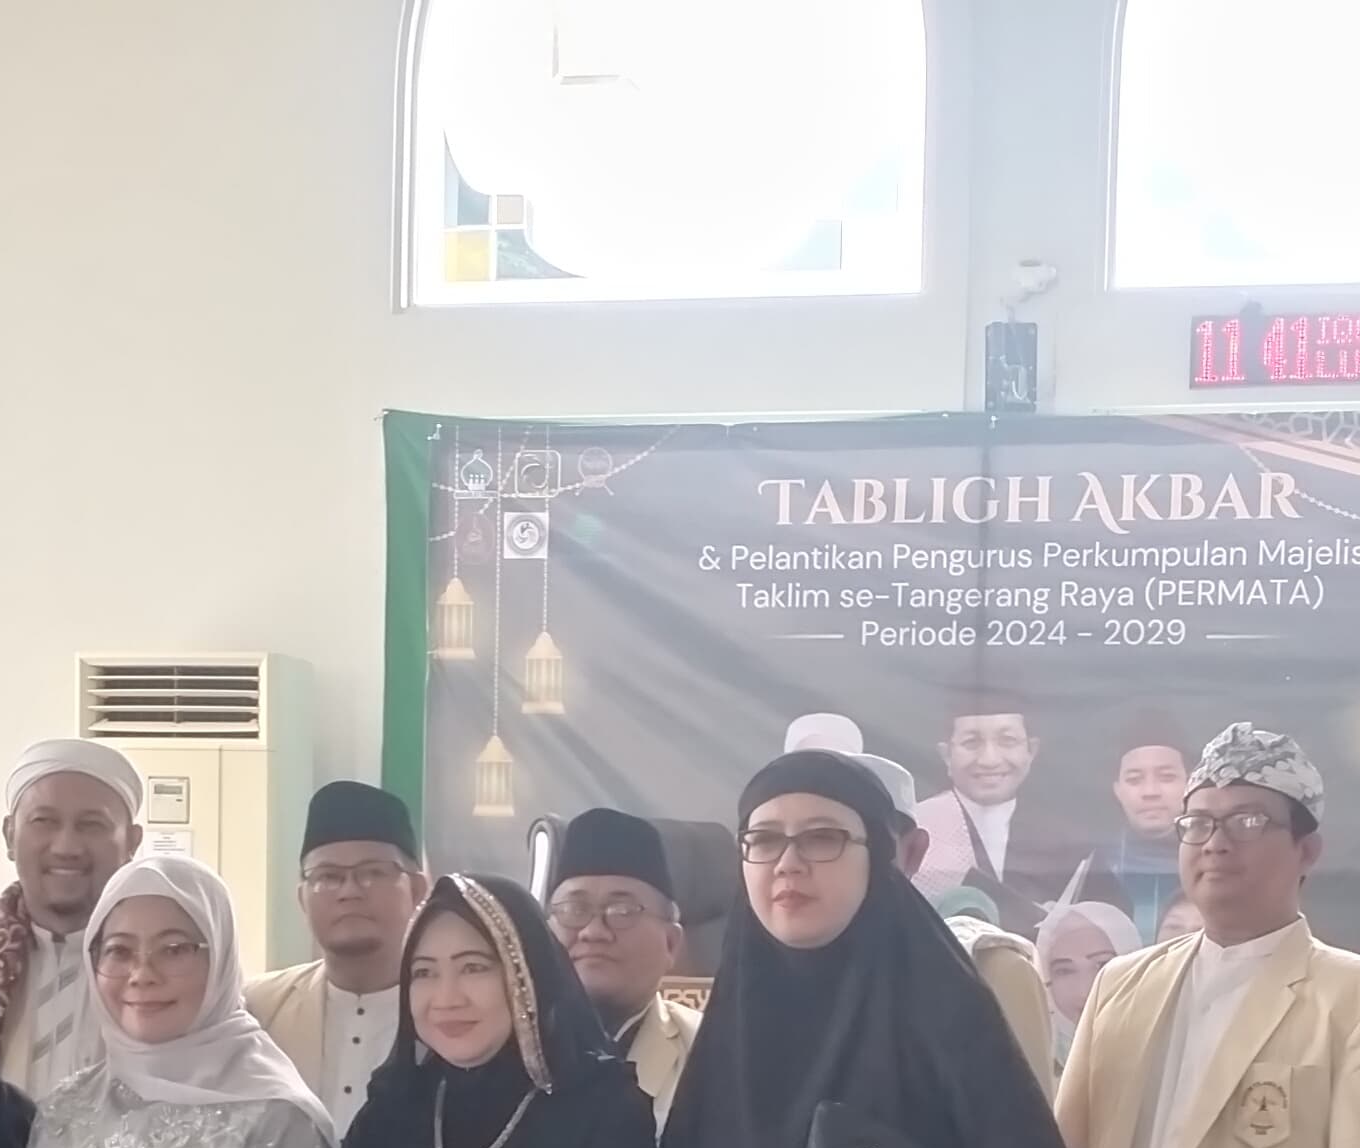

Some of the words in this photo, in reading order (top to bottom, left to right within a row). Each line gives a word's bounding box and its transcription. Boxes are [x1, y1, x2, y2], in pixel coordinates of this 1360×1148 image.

[757, 475, 1053, 526] TABLIGH
[1070, 471, 1304, 535] AKBAR
[698, 544, 721, 571] &
[731, 544, 883, 571] Pelantikan
[892, 543, 1033, 576] Pengurus
[1042, 539, 1248, 574] Perkumpulan
[736, 582, 830, 609] Taklim
[839, 581, 1051, 615] se-Tangerang
[1060, 580, 1135, 614] Raya
[1144, 575, 1325, 611] (PERMATA)
[860, 620, 977, 647] Periode
[986, 619, 1067, 646] 2024
[1103, 618, 1187, 646] 2029
